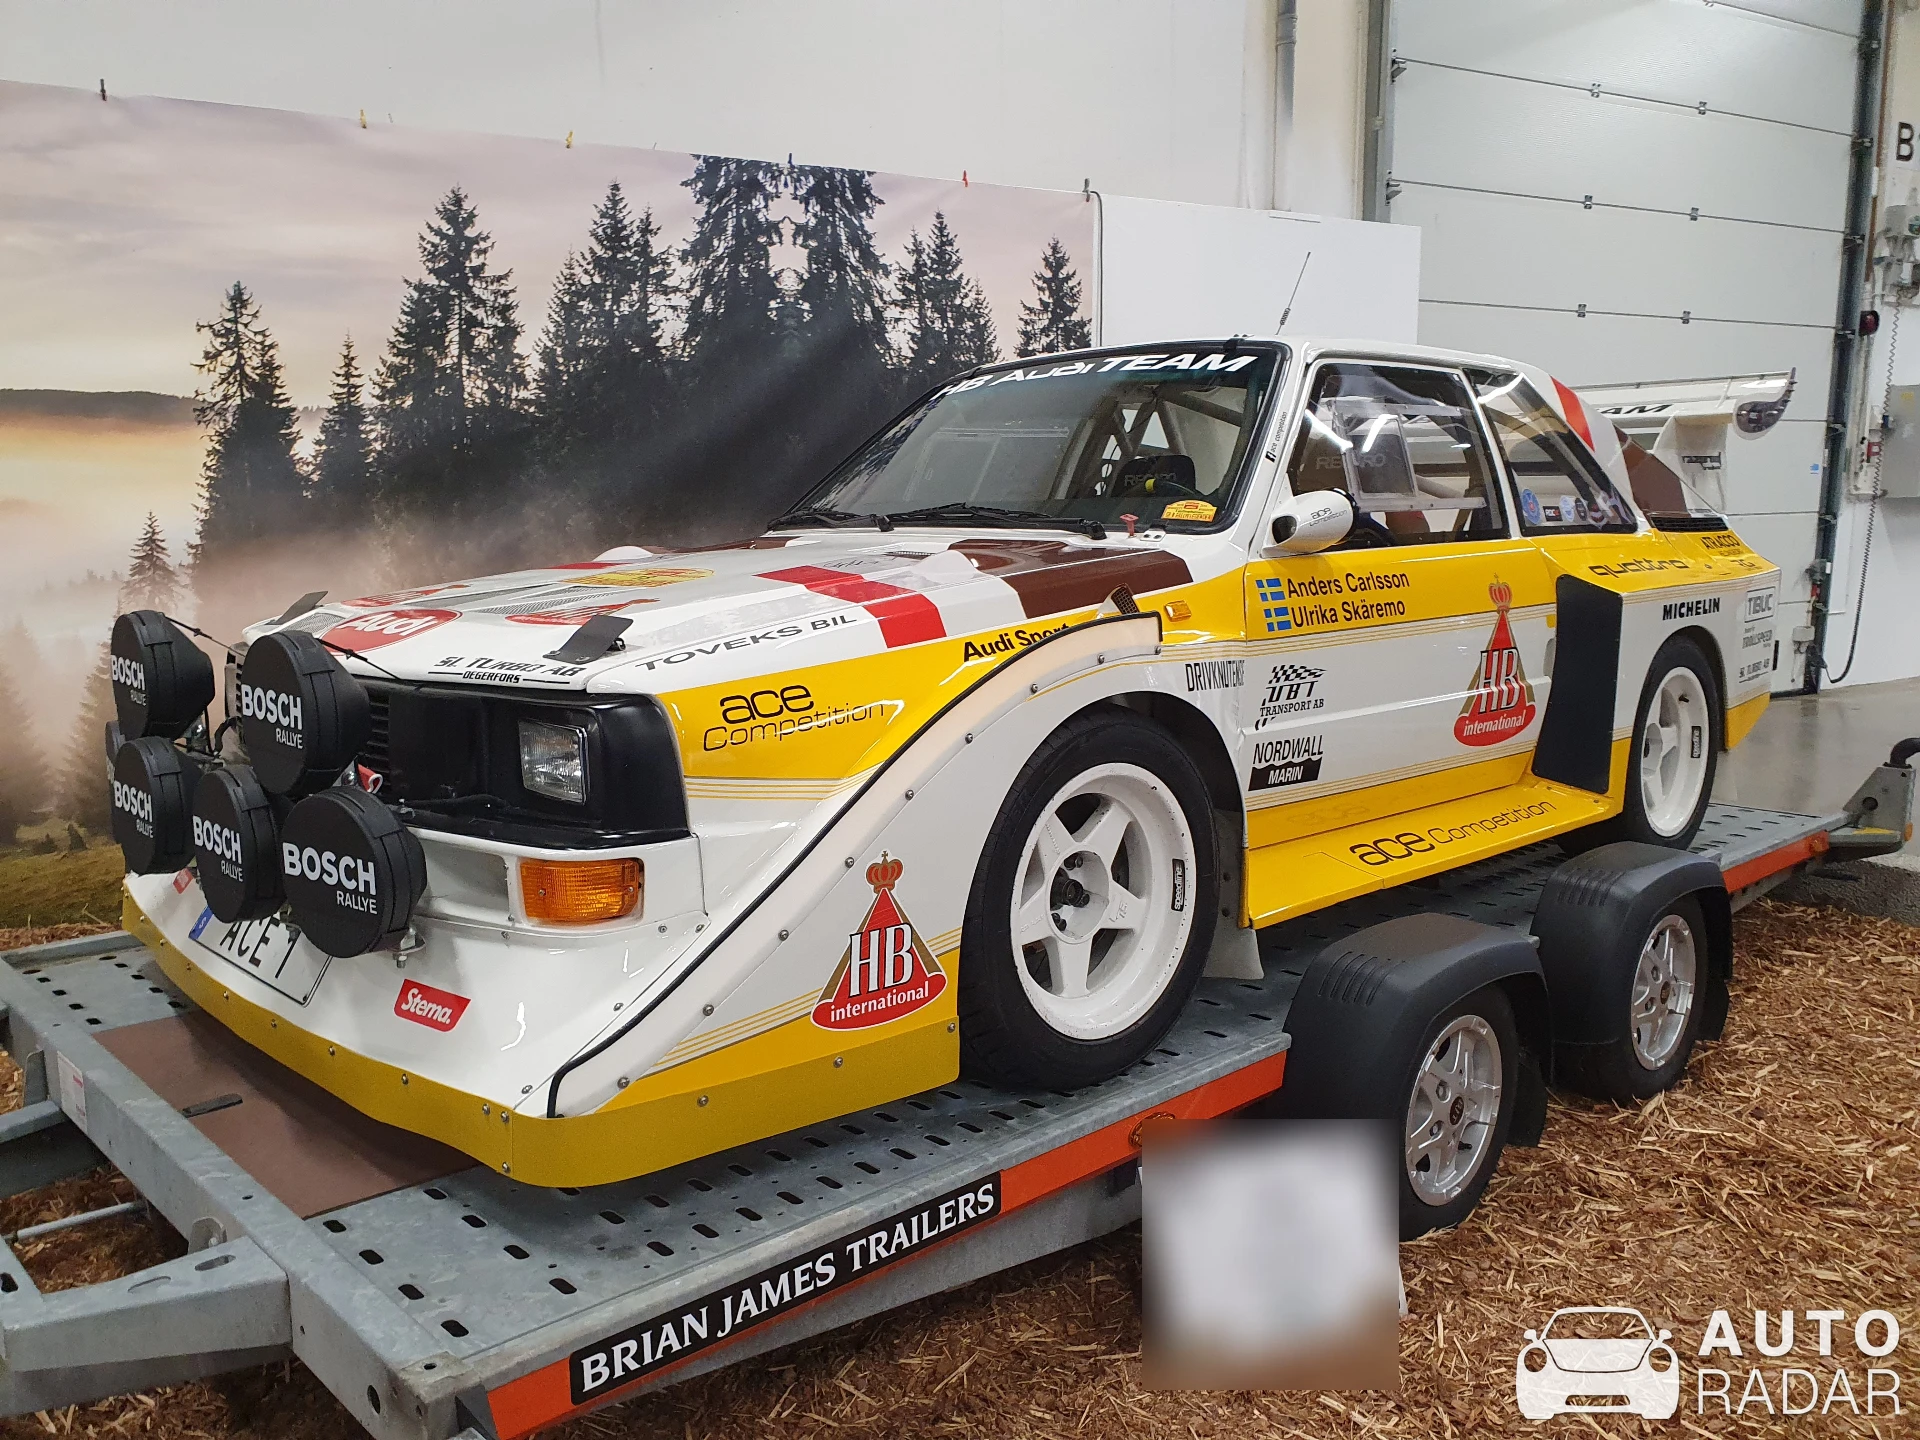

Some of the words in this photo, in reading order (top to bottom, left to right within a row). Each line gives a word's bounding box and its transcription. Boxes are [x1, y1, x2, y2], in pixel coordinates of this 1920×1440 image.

[930, 374, 994, 401] HB
[1097, 353, 1259, 373] TEAM
[1600, 404, 1675, 415] AM
[1315, 453, 1387, 471] RERO
[1310, 507, 1332, 519] ace
[1588, 558, 1690, 579] quattro
[1286, 575, 1343, 598] Anders
[1345, 571, 1410, 593] Carlsson
[336, 611, 439, 637] Audi
[1291, 603, 1339, 628] Ulrika
[1341, 599, 1405, 622] Skäremo
[1663, 597, 1720, 621] MICHELIN
[634, 625, 803, 671] TOVEKS
[811, 614, 858, 631] BIL
[963, 632, 1015, 663] Audi
[110, 654, 146, 691] BOSCH
[434, 656, 465, 668] SL
[466, 657, 546, 672] TURBO
[540, 665, 587, 677] AB
[462, 670, 522, 684] DEGERFORS
[1478, 646, 1520, 715] HB
[241, 683, 304, 731] BOSCH
[719, 684, 814, 725] ace
[1260, 700, 1312, 717] TRANSPORT
[1313, 698, 1325, 710] AB
[275, 727, 304, 750] RALLYE
[703, 702, 885, 752] Competition
[1463, 710, 1527, 737] international
[1253, 734, 1323, 765] NORDWALL
[1267, 765, 1304, 785] MARIN
[113, 779, 153, 823] BOSCH
[135, 818, 153, 839] RALLYE
[192, 815, 243, 864] BOSCH
[1349, 832, 1436, 866] ace
[1427, 799, 1557, 845] Competition
[220, 859, 244, 882] RALLYE
[282, 842, 378, 897] BOSCH
[336, 890, 378, 915] RALLYE
[1174, 866, 1184, 911] speedline
[219, 915, 281, 968] ACE
[849, 922, 913, 998] HB
[830, 981, 929, 1022] international
[580, 1304, 709, 1393] BRIAN
[716, 1251, 836, 1337] JAMES
[845, 1183, 995, 1273] TRAILERS
